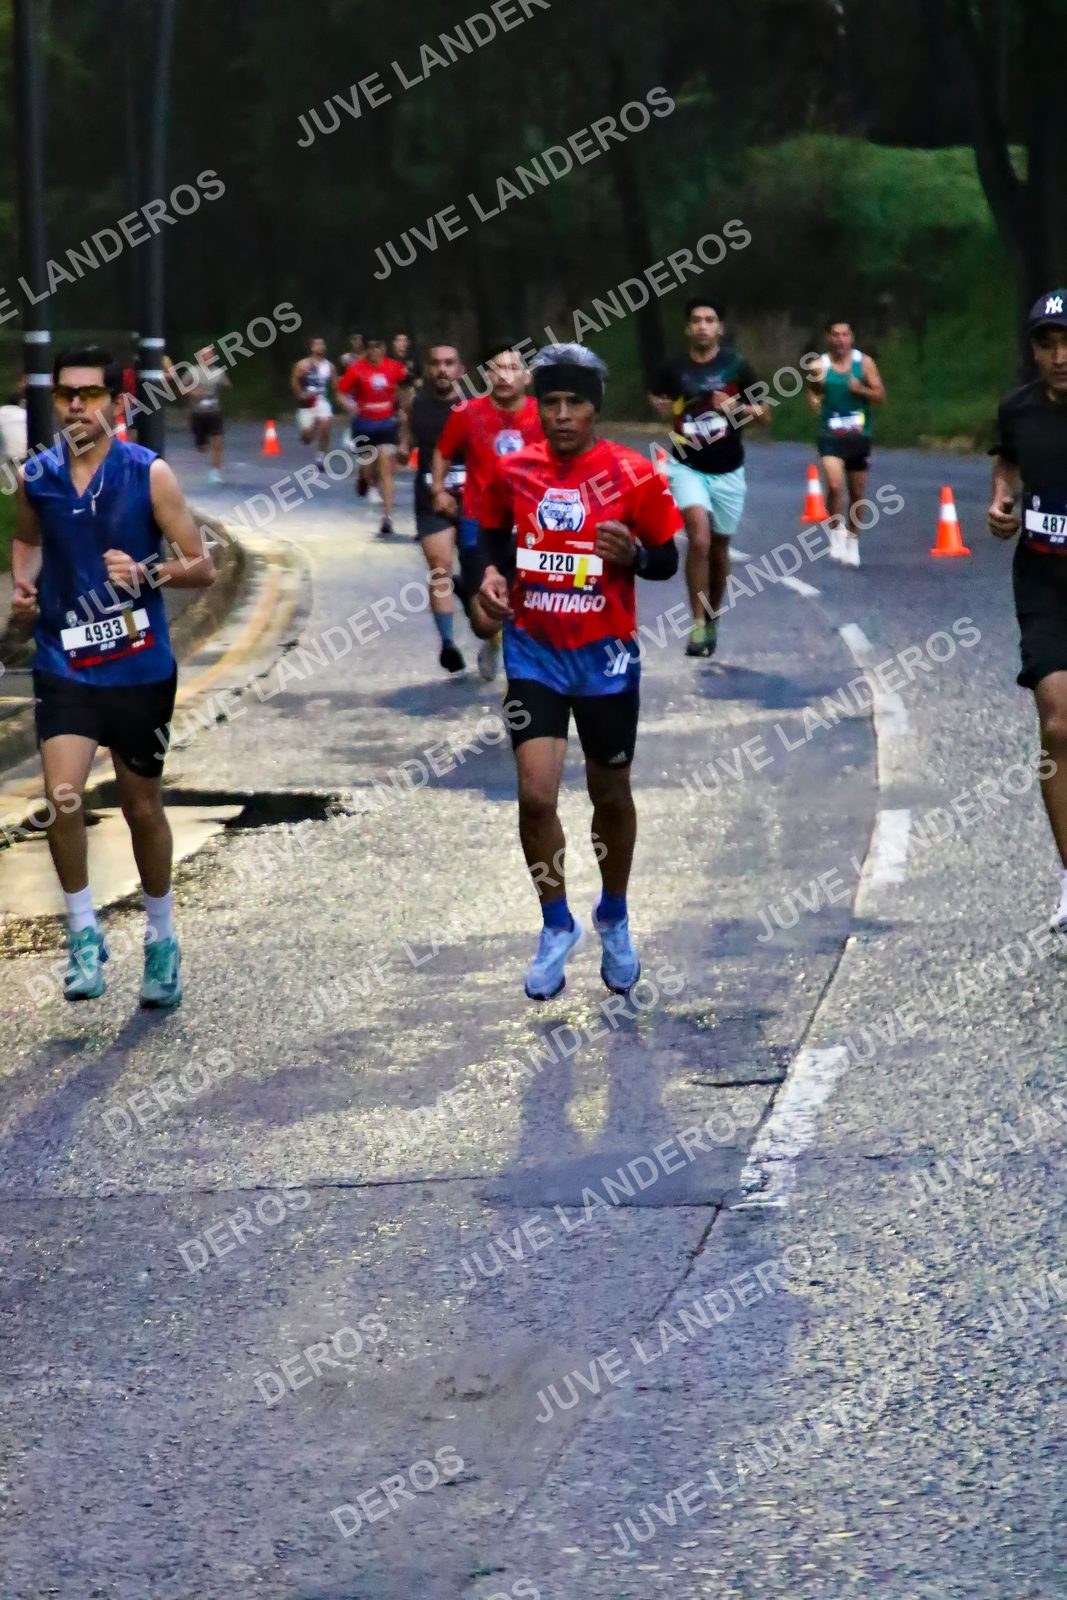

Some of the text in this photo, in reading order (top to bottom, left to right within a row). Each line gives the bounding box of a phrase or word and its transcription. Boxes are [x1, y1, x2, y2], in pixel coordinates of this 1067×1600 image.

[539, 553, 574, 572] 2120
[523, 591, 607, 613] SANTIAGO
[85, 619, 123, 642] 4933
